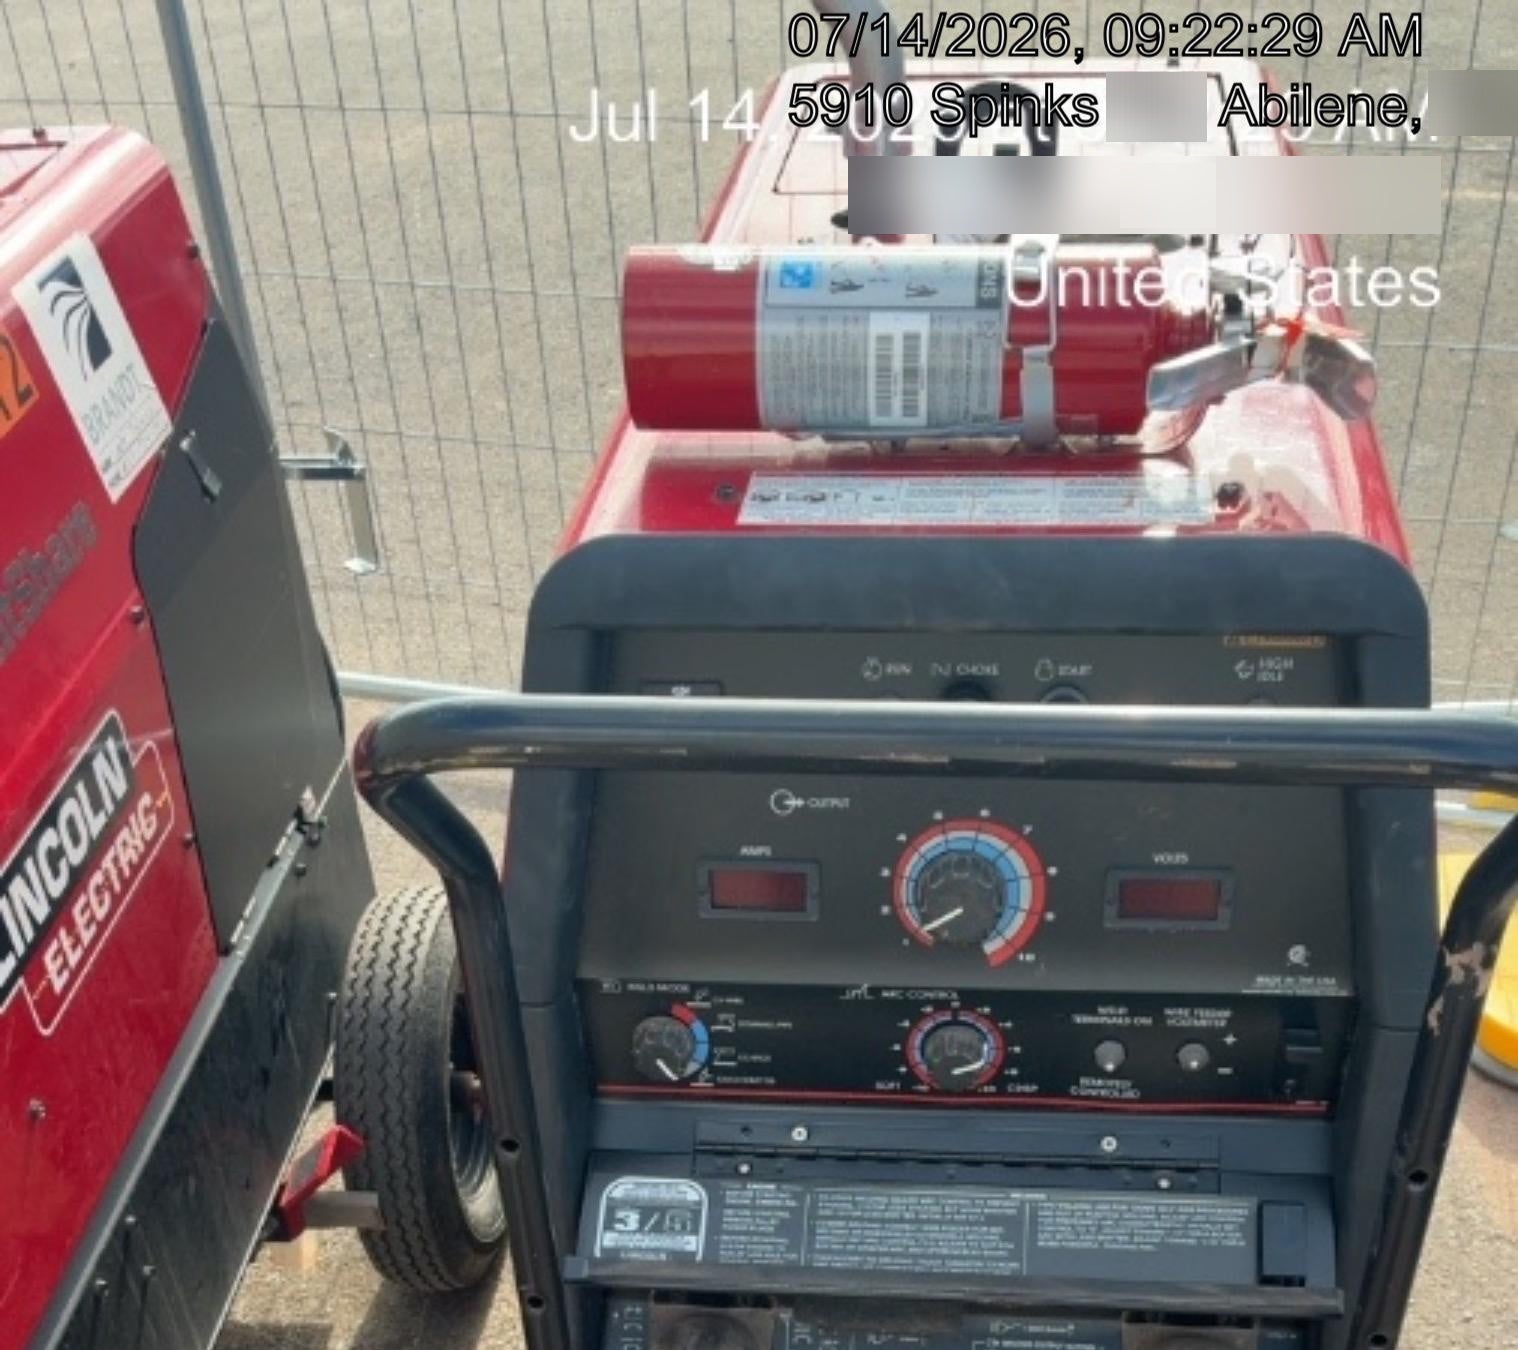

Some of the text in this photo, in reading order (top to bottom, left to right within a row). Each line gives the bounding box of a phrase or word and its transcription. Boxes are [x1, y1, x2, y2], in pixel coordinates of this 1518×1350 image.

[956, 662, 1000, 676] CHOKE
[806, 797, 851, 809] OUTPUT
[1152, 851, 1189, 864] VOLTS
[44, 791, 157, 996] ELECTRIC
